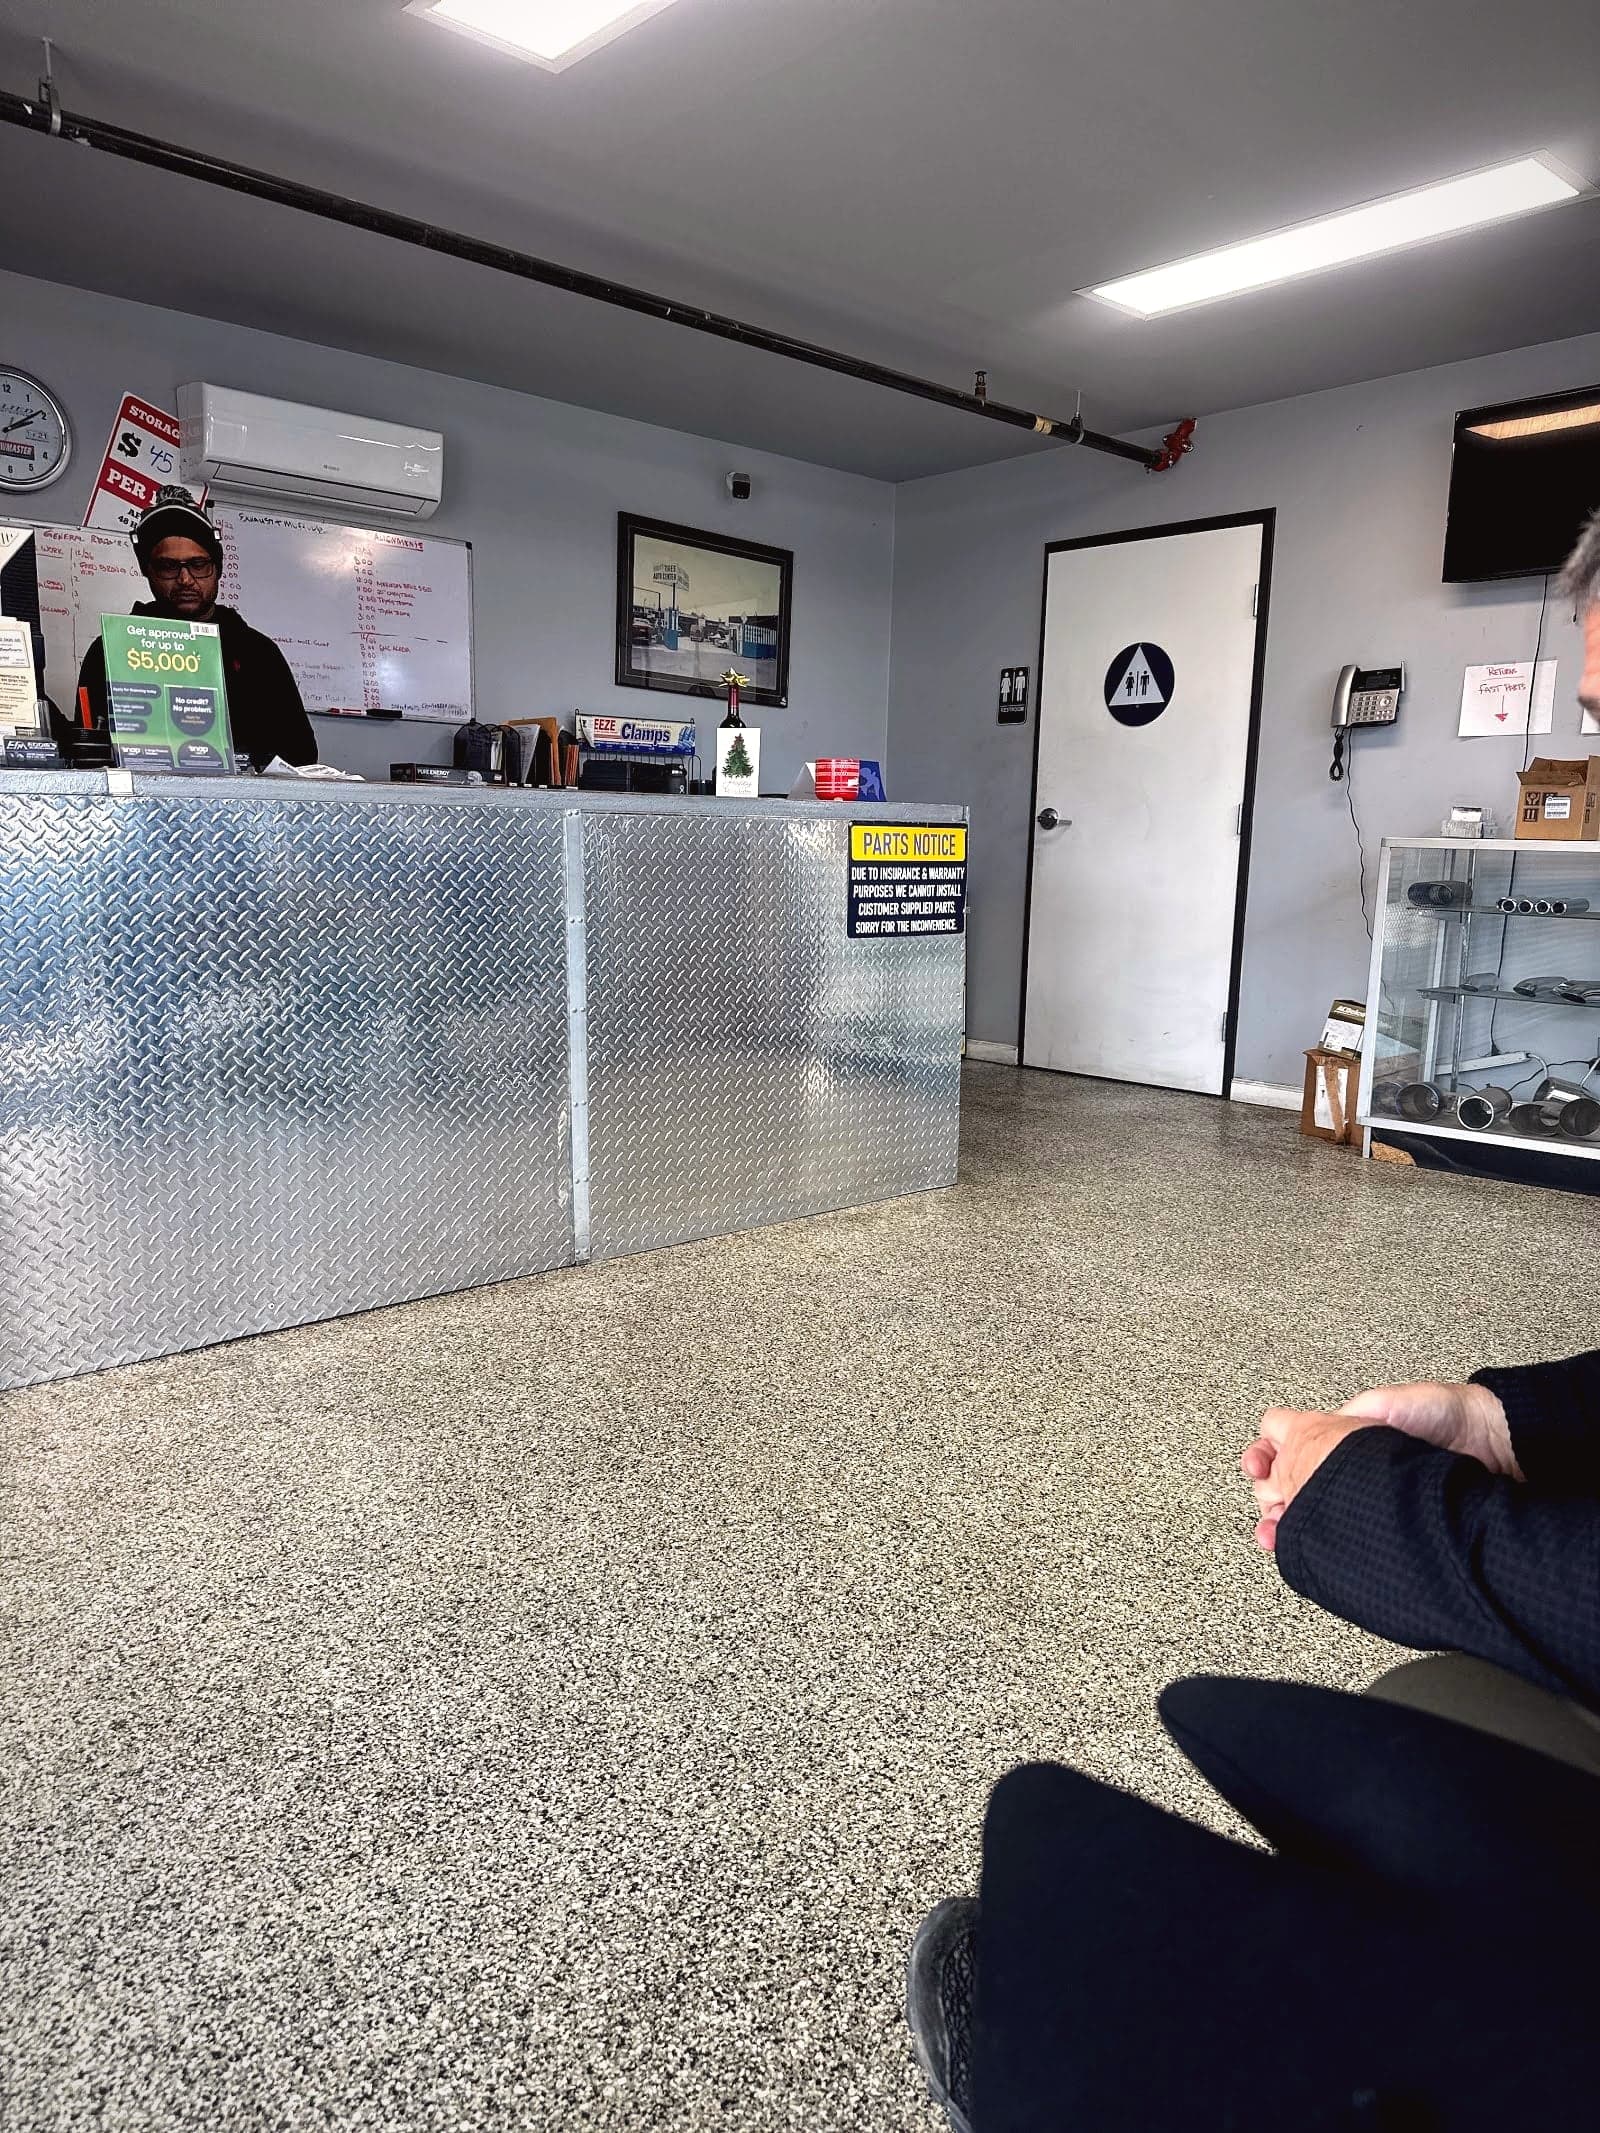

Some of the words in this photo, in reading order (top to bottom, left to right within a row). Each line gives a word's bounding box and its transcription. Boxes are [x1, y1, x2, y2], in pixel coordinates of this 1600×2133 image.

[129, 405, 180, 440] STORAG
[0, 442, 32, 456] WMASTER
[106, 468, 146, 500] PER
[127, 625, 147, 636] Get
[148, 628, 196, 641] approved
[141, 639, 155, 648] for
[158, 640, 172, 653] up
[174, 640, 185, 651] to
[127, 647, 199, 673] $5,000
[175, 696, 185, 704] No
[186, 697, 209, 706] credit?
[172, 704, 183, 713] No
[183, 705, 212, 714] problem.
[621, 723, 671, 745] Clamps
[863, 832, 909, 856] PARTS
[913, 833, 956, 856] NOTICE
[851, 866, 866, 880] DUE
[868, 867, 878, 880] TO
[880, 867, 920, 880] INSURANCE
[921, 867, 928, 880] &
[929, 867, 965, 880] WARRANTY
[853, 884, 894, 898] PURPOSES
[895, 885, 907, 898] WE
[908, 885, 935, 897] CANNOT
[936, 884, 961, 897] INSTALL
[858, 902, 900, 916] CUSTOMER
[900, 901, 933, 915] SUPPLIED
[934, 901, 956, 914] PARTS.
[855, 921, 880, 934] SORRY
[880, 920, 895, 933] FOR
[897, 920, 910, 932] THE
[910, 918, 957, 932] INCONVENIENCE.
